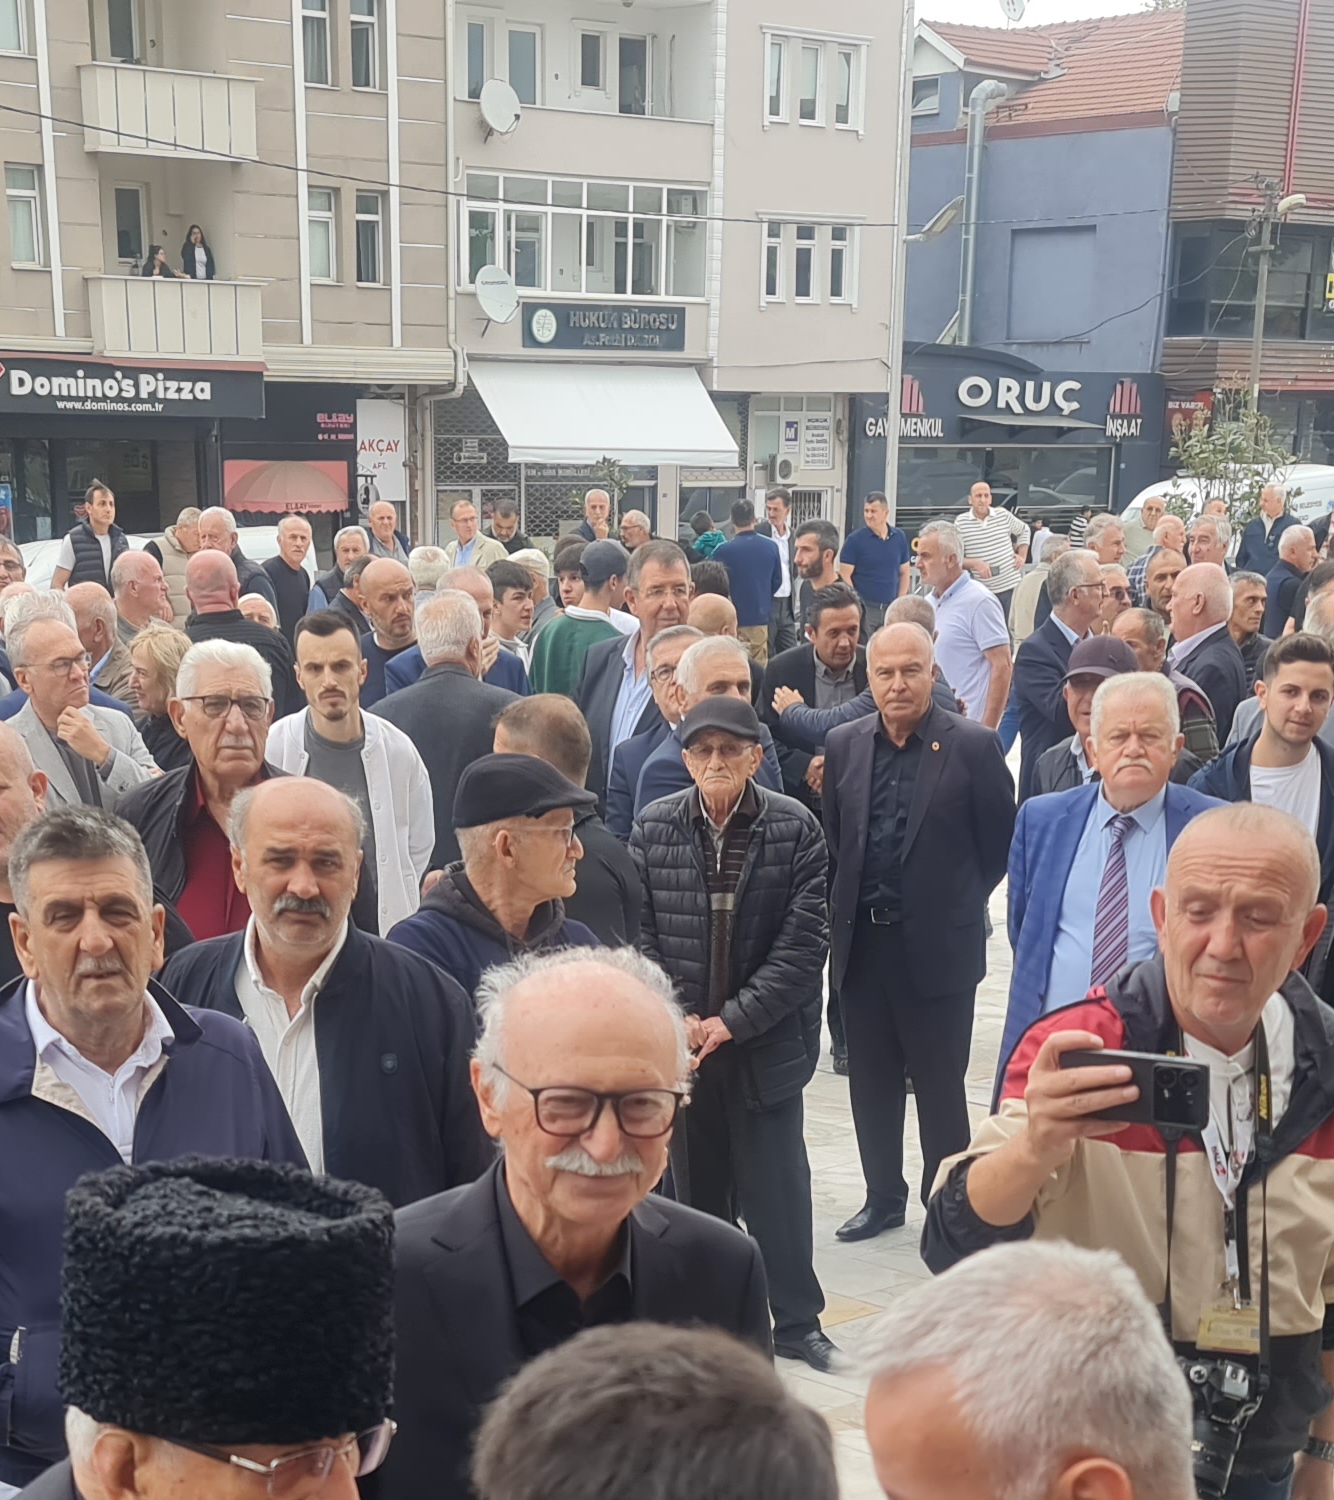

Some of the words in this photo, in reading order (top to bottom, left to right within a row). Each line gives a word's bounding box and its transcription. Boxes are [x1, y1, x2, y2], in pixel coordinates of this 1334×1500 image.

[569, 310, 617, 328] HUKUK
[621, 308, 678, 330] BÜROSU
[10, 369, 136, 398] Domino's
[139, 373, 211, 400] Pizza
[958, 375, 1082, 415] ORUÇ
[56, 400, 164, 412] www.dominos.com.tr
[865, 416, 944, 438] GAYMENKUL
[1106, 416, 1142, 441] İNŞAAT
[359, 439, 400, 456] AKÇAY
